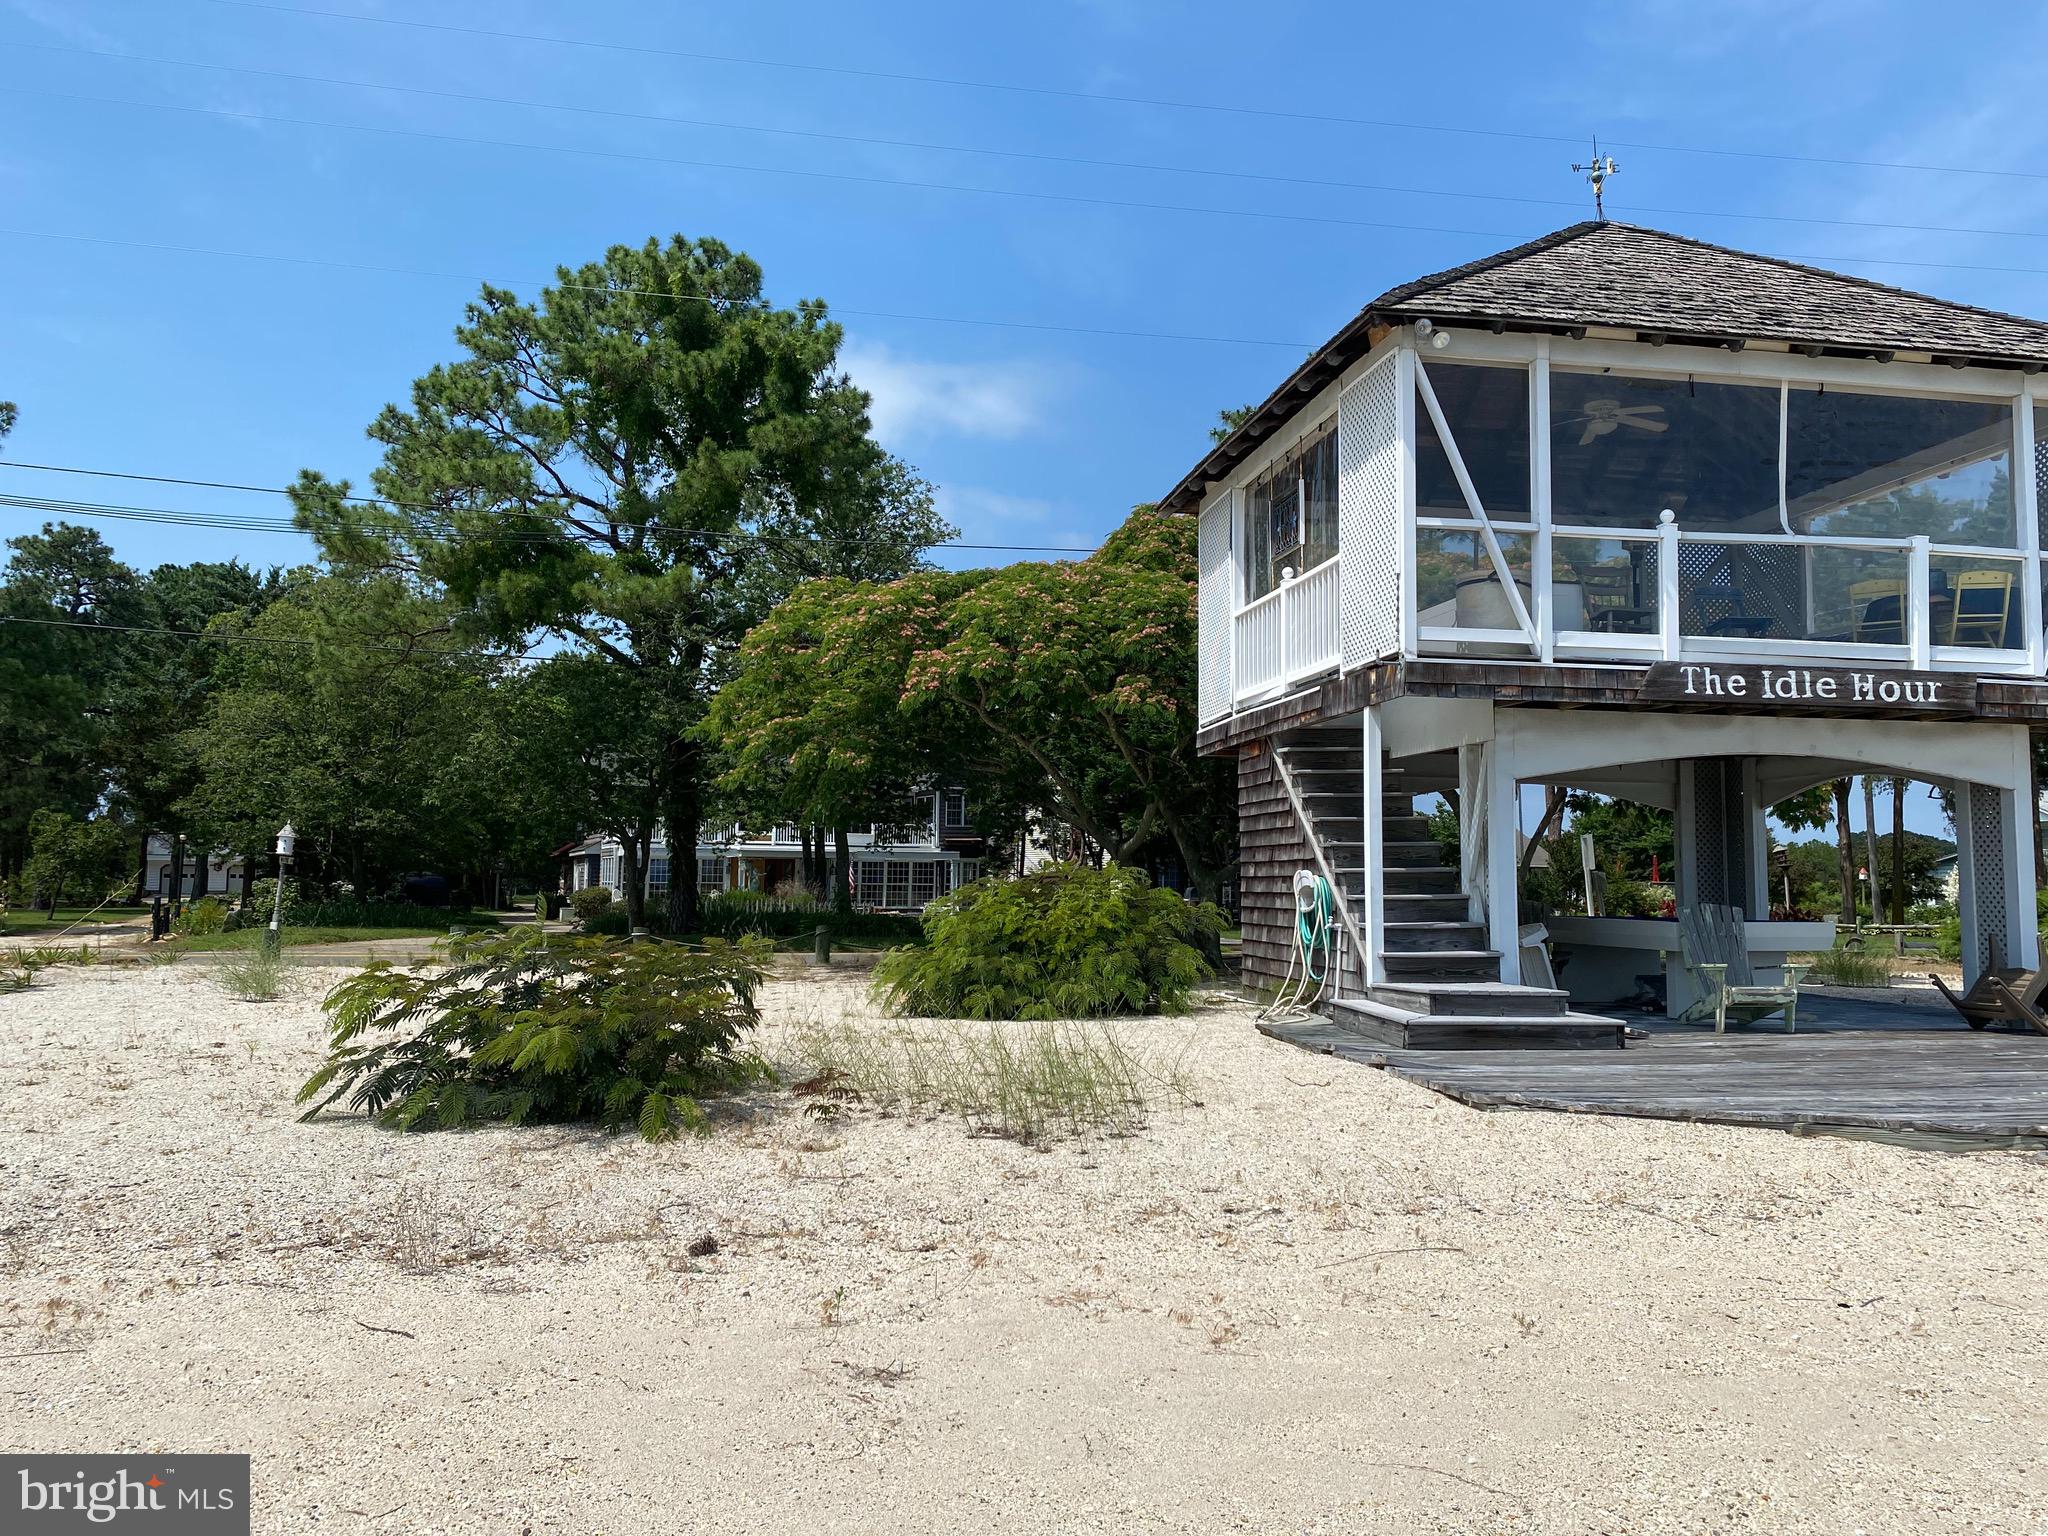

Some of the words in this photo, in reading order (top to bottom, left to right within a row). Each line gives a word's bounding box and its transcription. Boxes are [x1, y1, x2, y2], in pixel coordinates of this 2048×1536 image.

[1571, 164, 1581, 173] W
[1680, 666, 1747, 696] The
[1761, 670, 1837, 699] Idle
[1850, 673, 1942, 702] Hour
